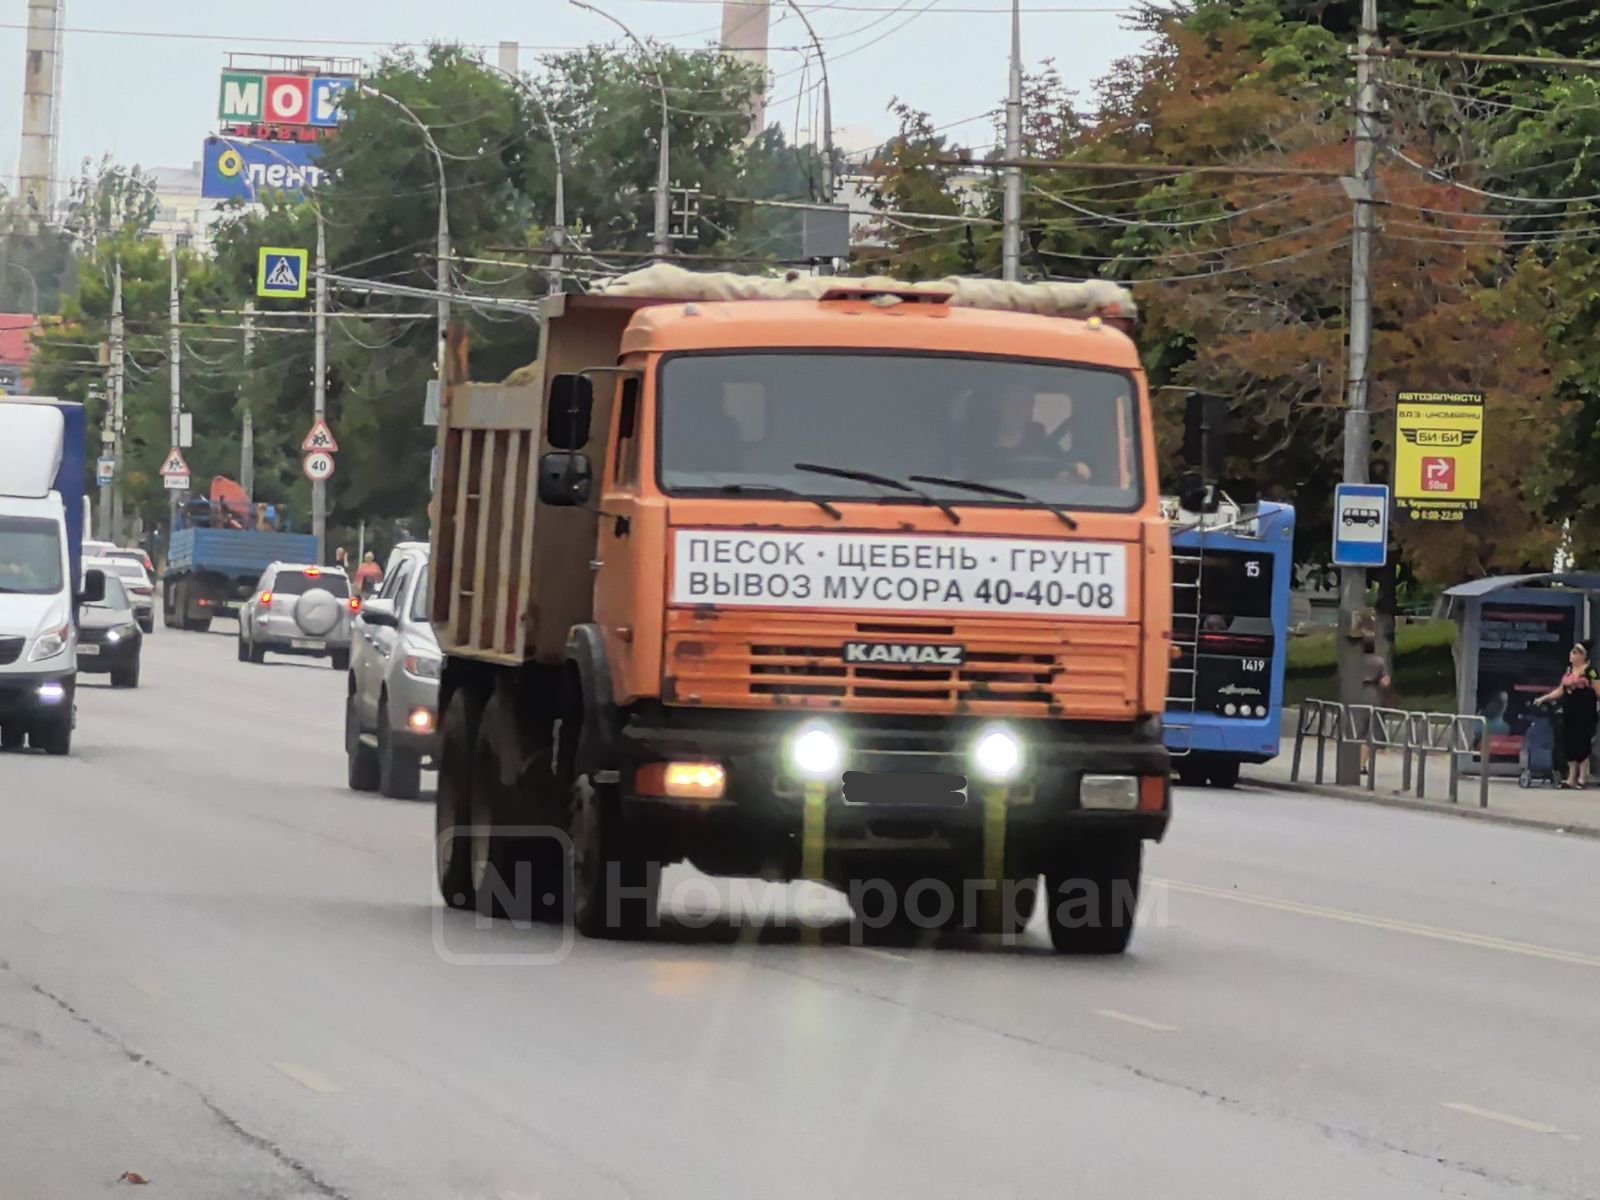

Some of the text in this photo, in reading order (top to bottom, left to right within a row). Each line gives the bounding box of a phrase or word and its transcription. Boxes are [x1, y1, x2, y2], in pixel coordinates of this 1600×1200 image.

[312, 461, 327, 471] 40
[689, 539, 1111, 575] ПЕСОК ЩЕБЕНЬ ГРУНТ
[1245, 561, 1260, 577] 15
[689, 572, 1113, 609] ВЫВОЗ МУСОРА 40-40-08
[847, 643, 962, 664] KAMAZ
[1242, 659, 1264, 671] 1419
